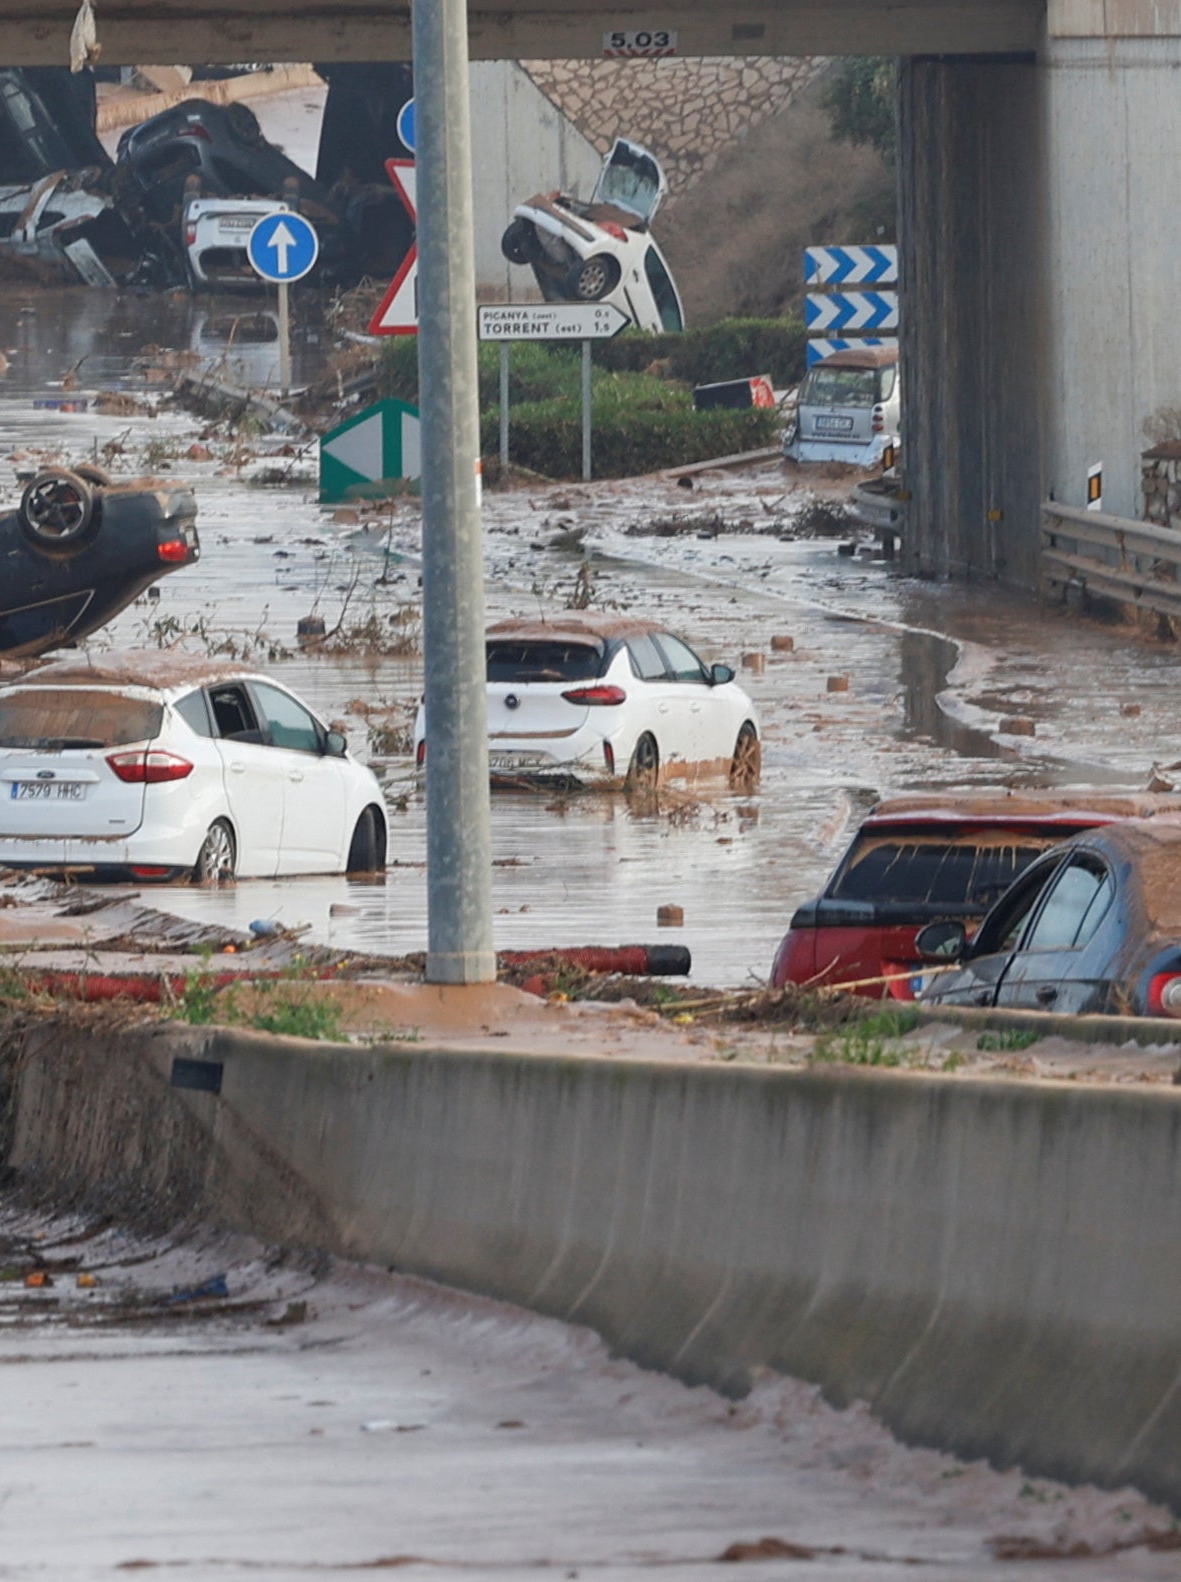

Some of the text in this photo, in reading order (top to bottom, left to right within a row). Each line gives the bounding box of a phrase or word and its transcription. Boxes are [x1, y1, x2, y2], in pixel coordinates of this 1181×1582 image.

[483, 311, 529, 321] PICANYA
[484, 321, 550, 334] TORRENT
[19, 782, 82, 799] 7579 HHC
